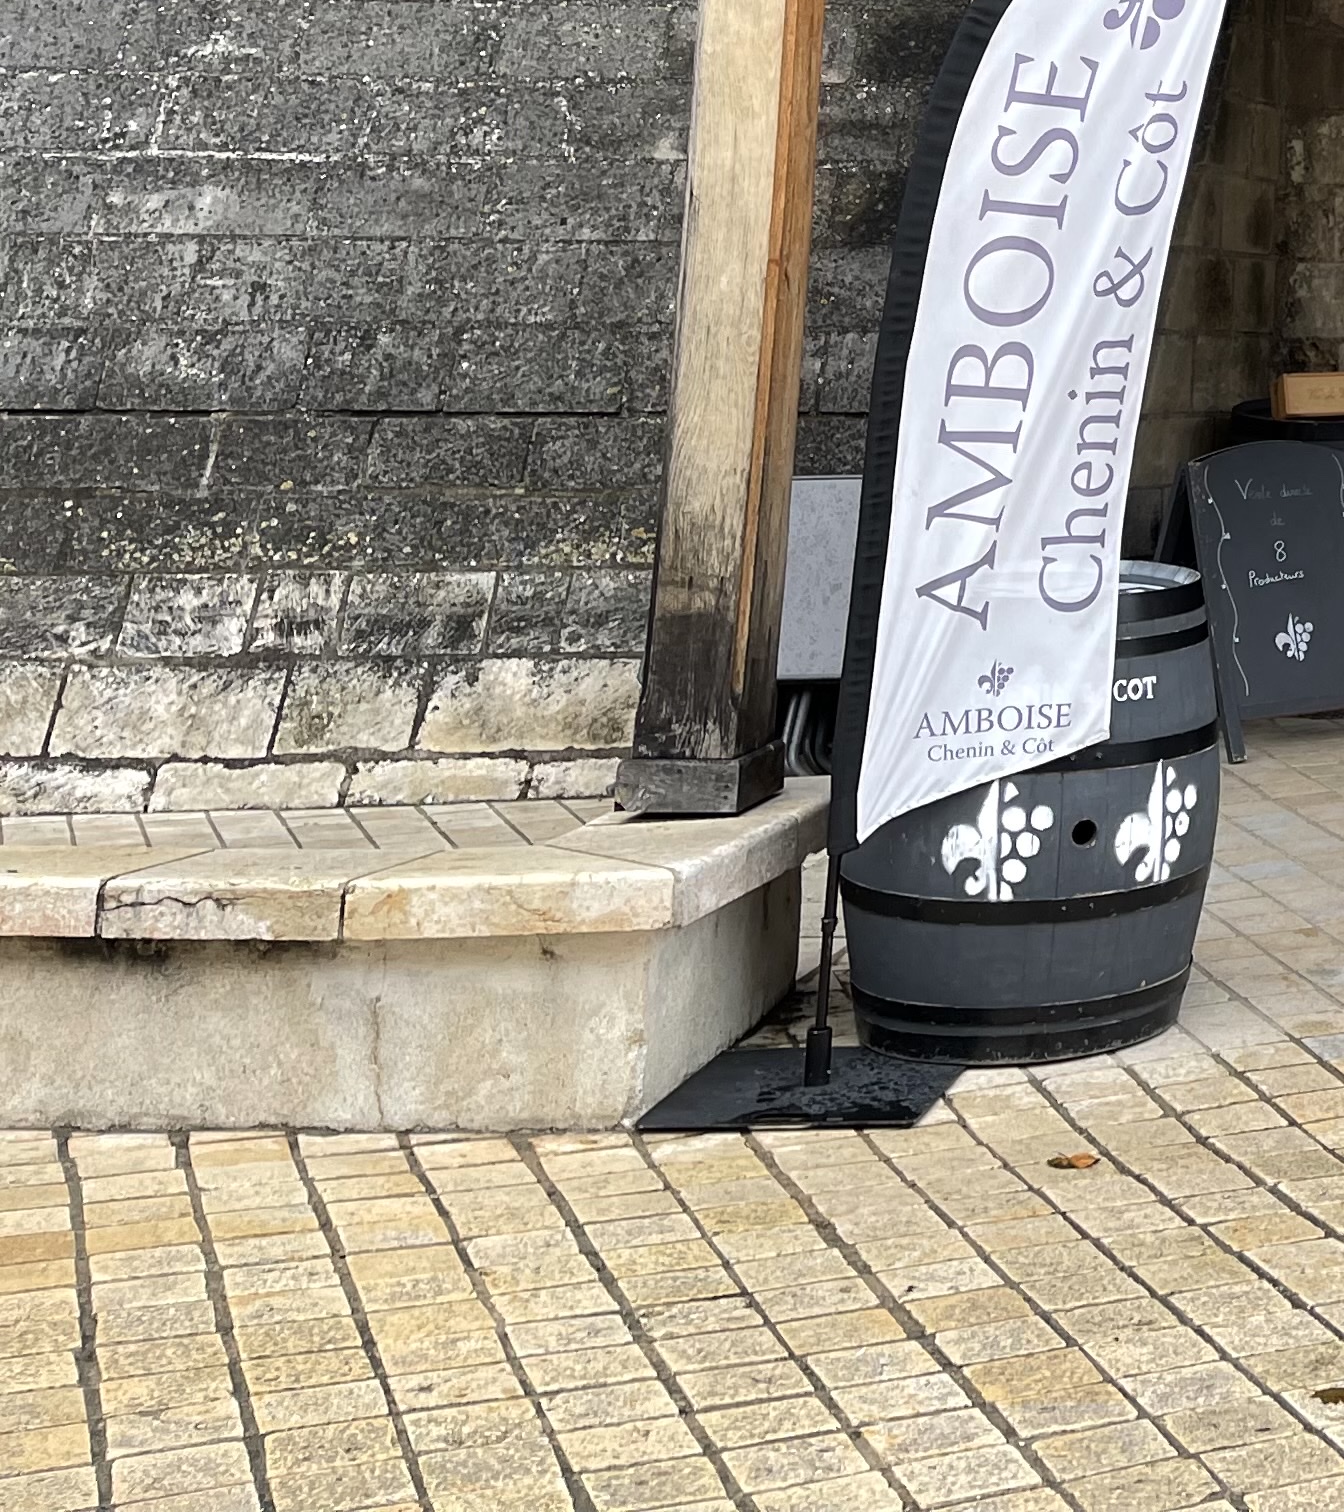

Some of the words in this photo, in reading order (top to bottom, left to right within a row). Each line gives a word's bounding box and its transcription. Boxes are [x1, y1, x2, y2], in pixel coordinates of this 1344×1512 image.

[1114, 78, 1188, 217] Côt
[1092, 245, 1153, 309] &
[916, 52, 1099, 631] AMBOISE
[1038, 333, 1135, 613] Chenin
[1274, 540, 1287, 562] 8
[1248, 570, 1305, 588] Producteurs
[1112, 675, 1157, 702] COT
[912, 702, 1073, 740] AMBOISE
[927, 741, 995, 763] Chenin
[1000, 739, 1016, 757] &
[1022, 737, 1055, 756] Côt
